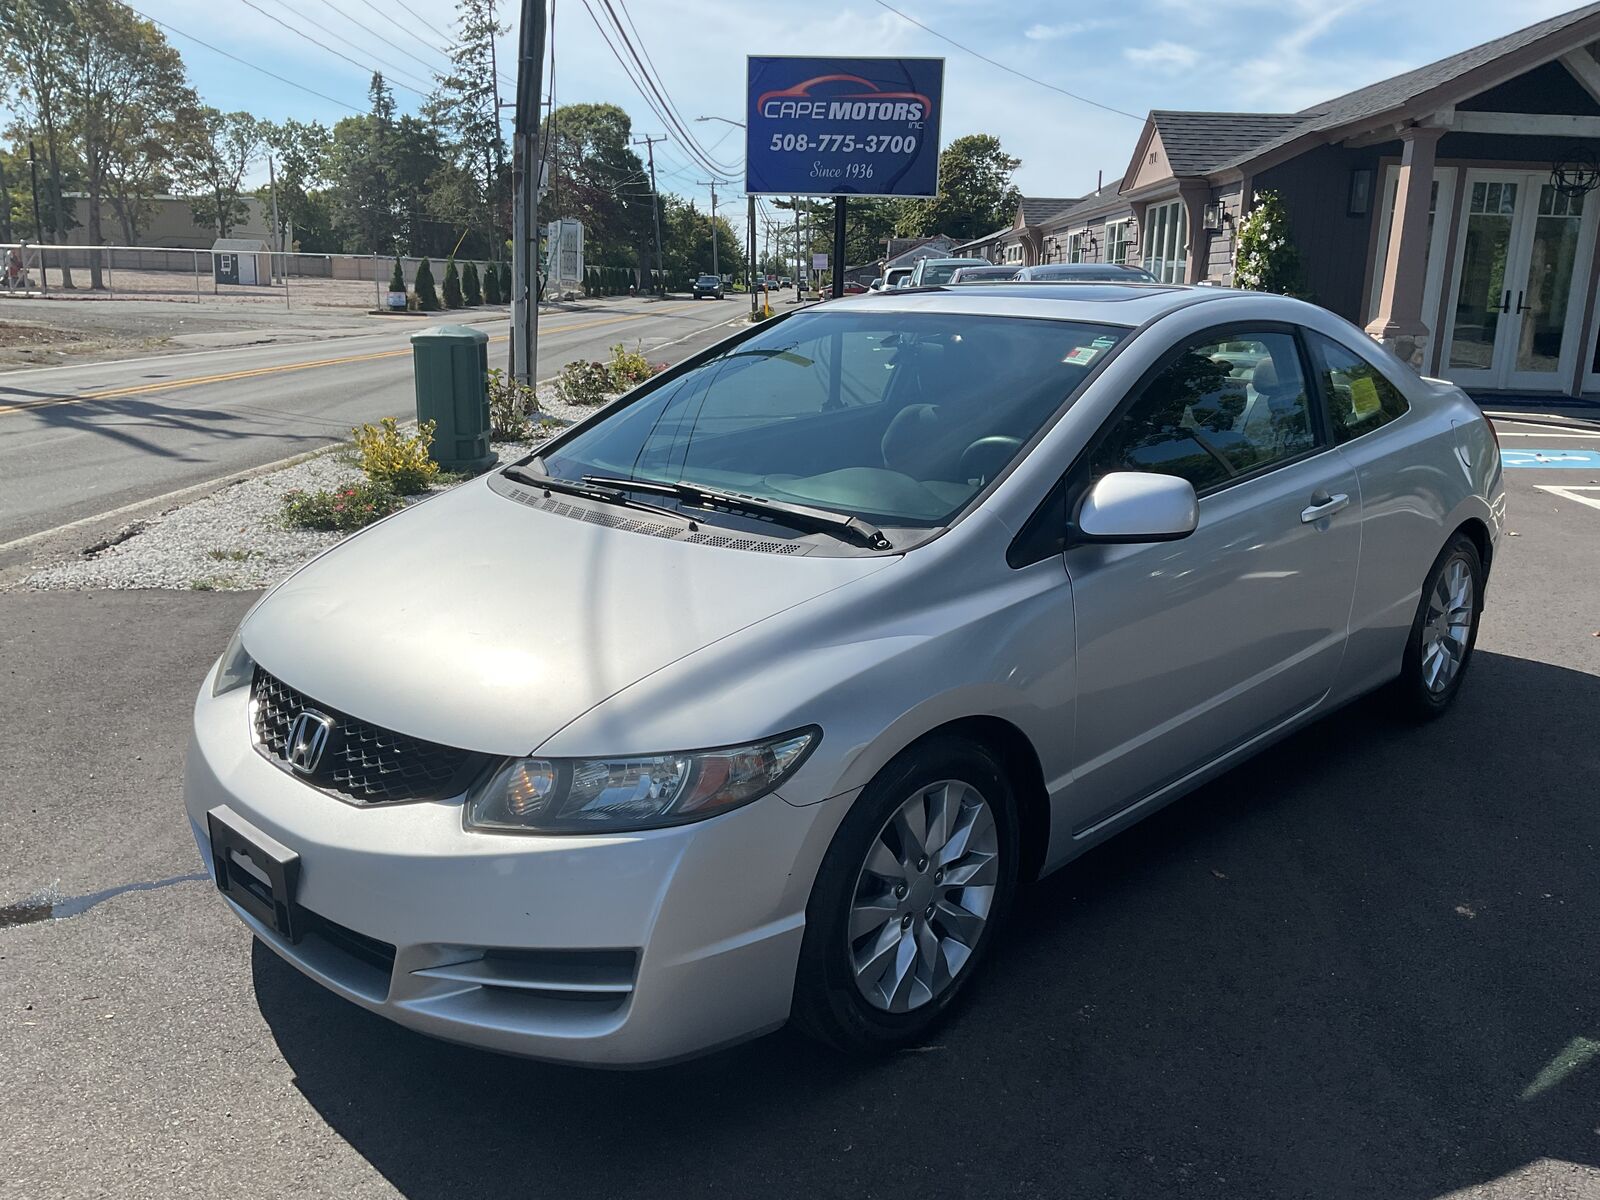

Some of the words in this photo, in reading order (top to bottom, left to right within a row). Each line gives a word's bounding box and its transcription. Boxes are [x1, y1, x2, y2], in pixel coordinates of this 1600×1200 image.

[764, 101, 827, 119] CAPE
[828, 102, 923, 121] MOTORS
[770, 133, 917, 154] 508-775-3700
[809, 160, 842, 178] Since
[845, 163, 874, 179] 1936
